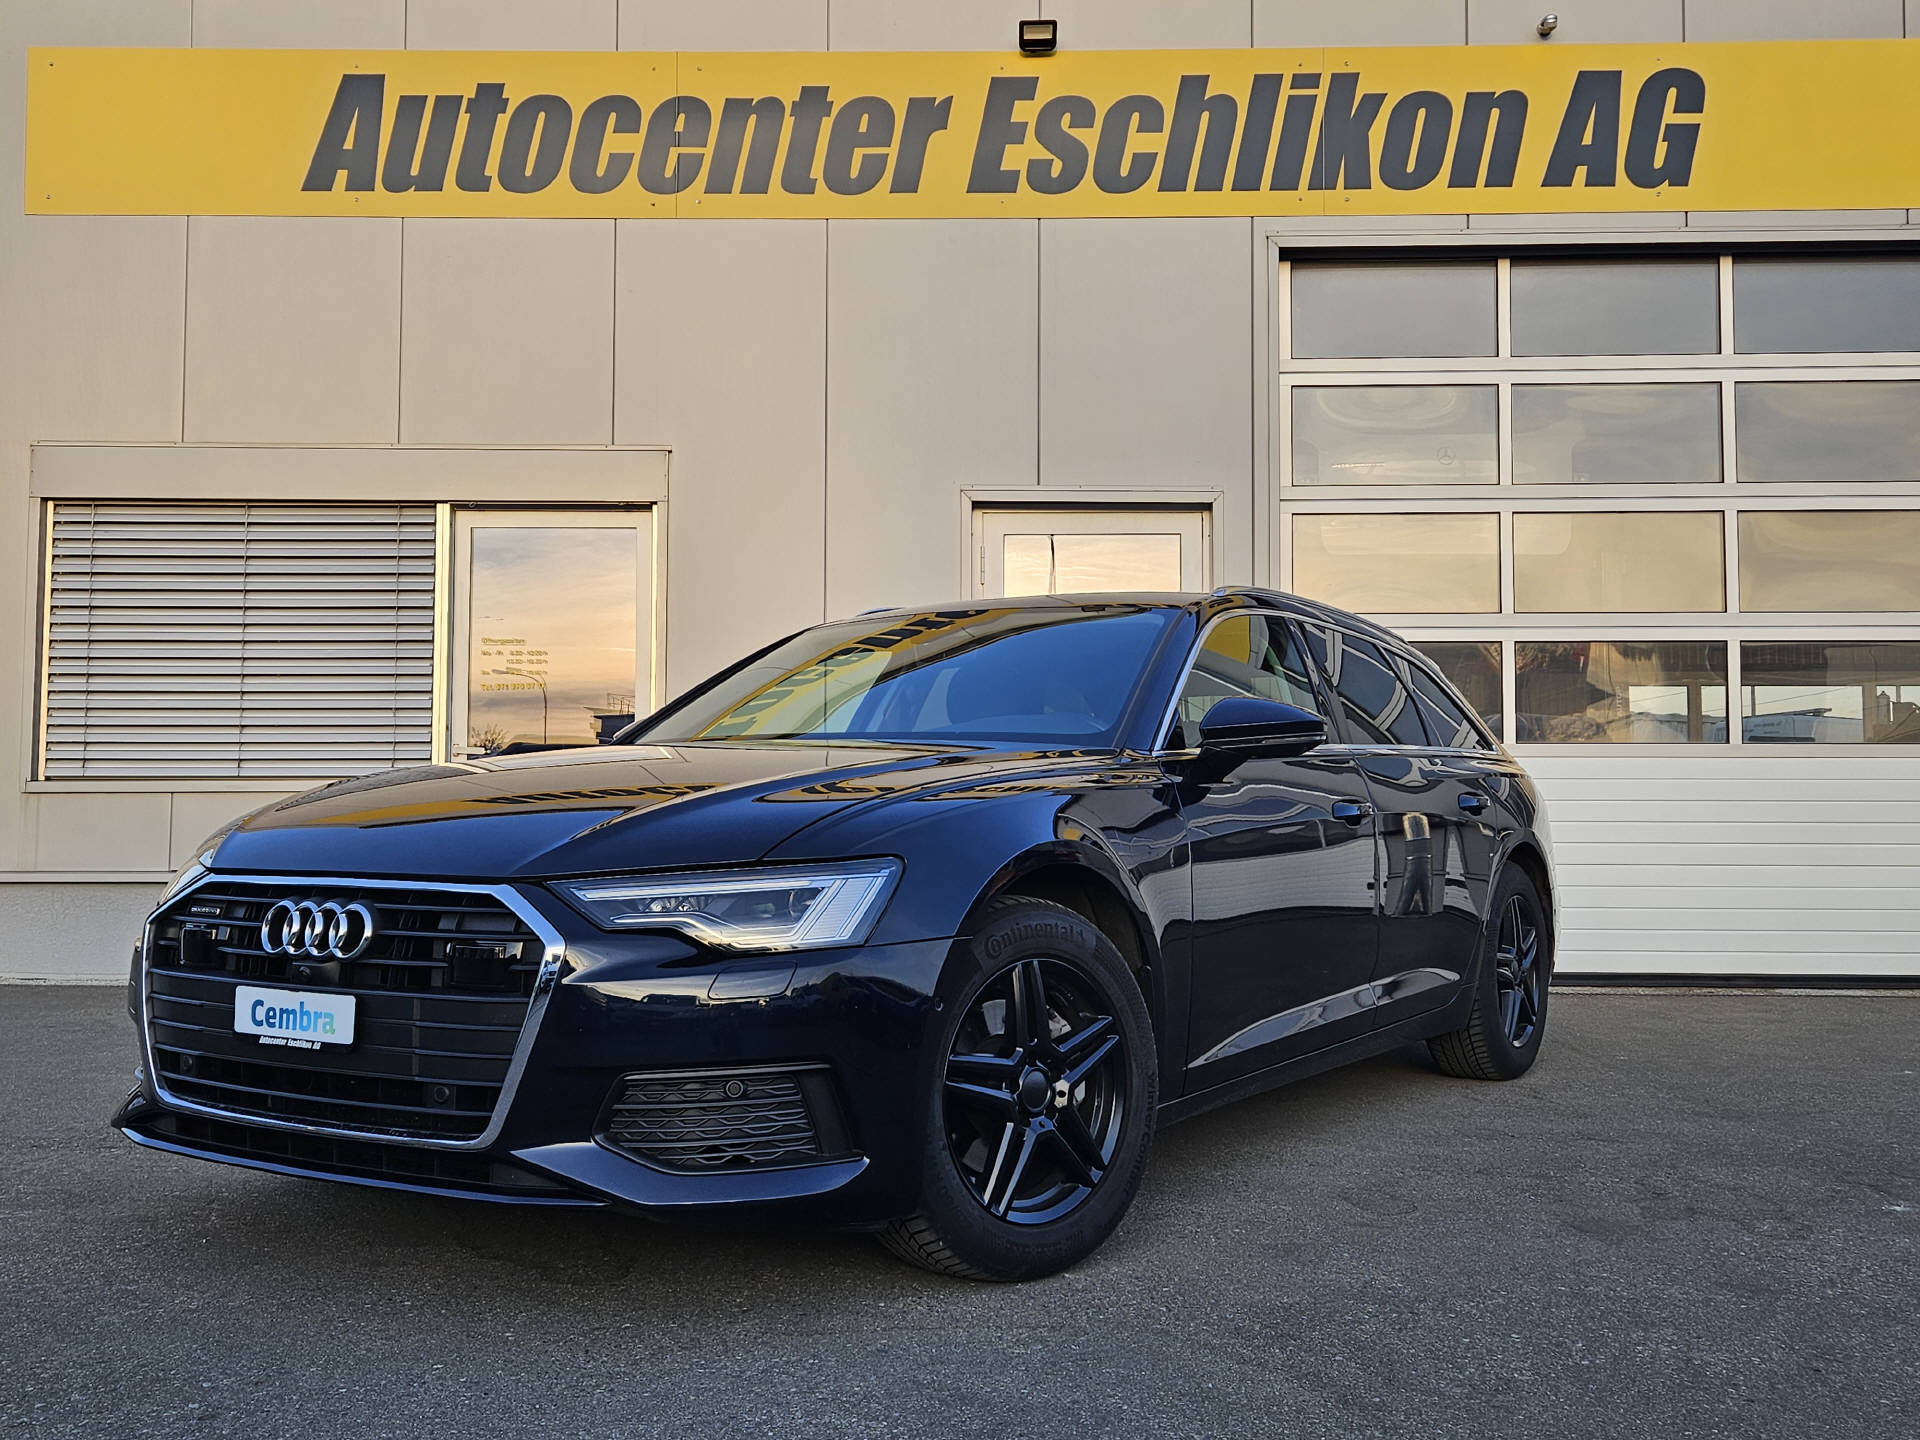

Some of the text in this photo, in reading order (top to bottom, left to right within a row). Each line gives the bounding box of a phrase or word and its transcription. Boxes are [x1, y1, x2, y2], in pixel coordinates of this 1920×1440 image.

[301, 67, 1706, 196] Autocenter Eschlikon AG
[986, 922, 1076, 958] Continental
[251, 999, 336, 1035] Cembra
